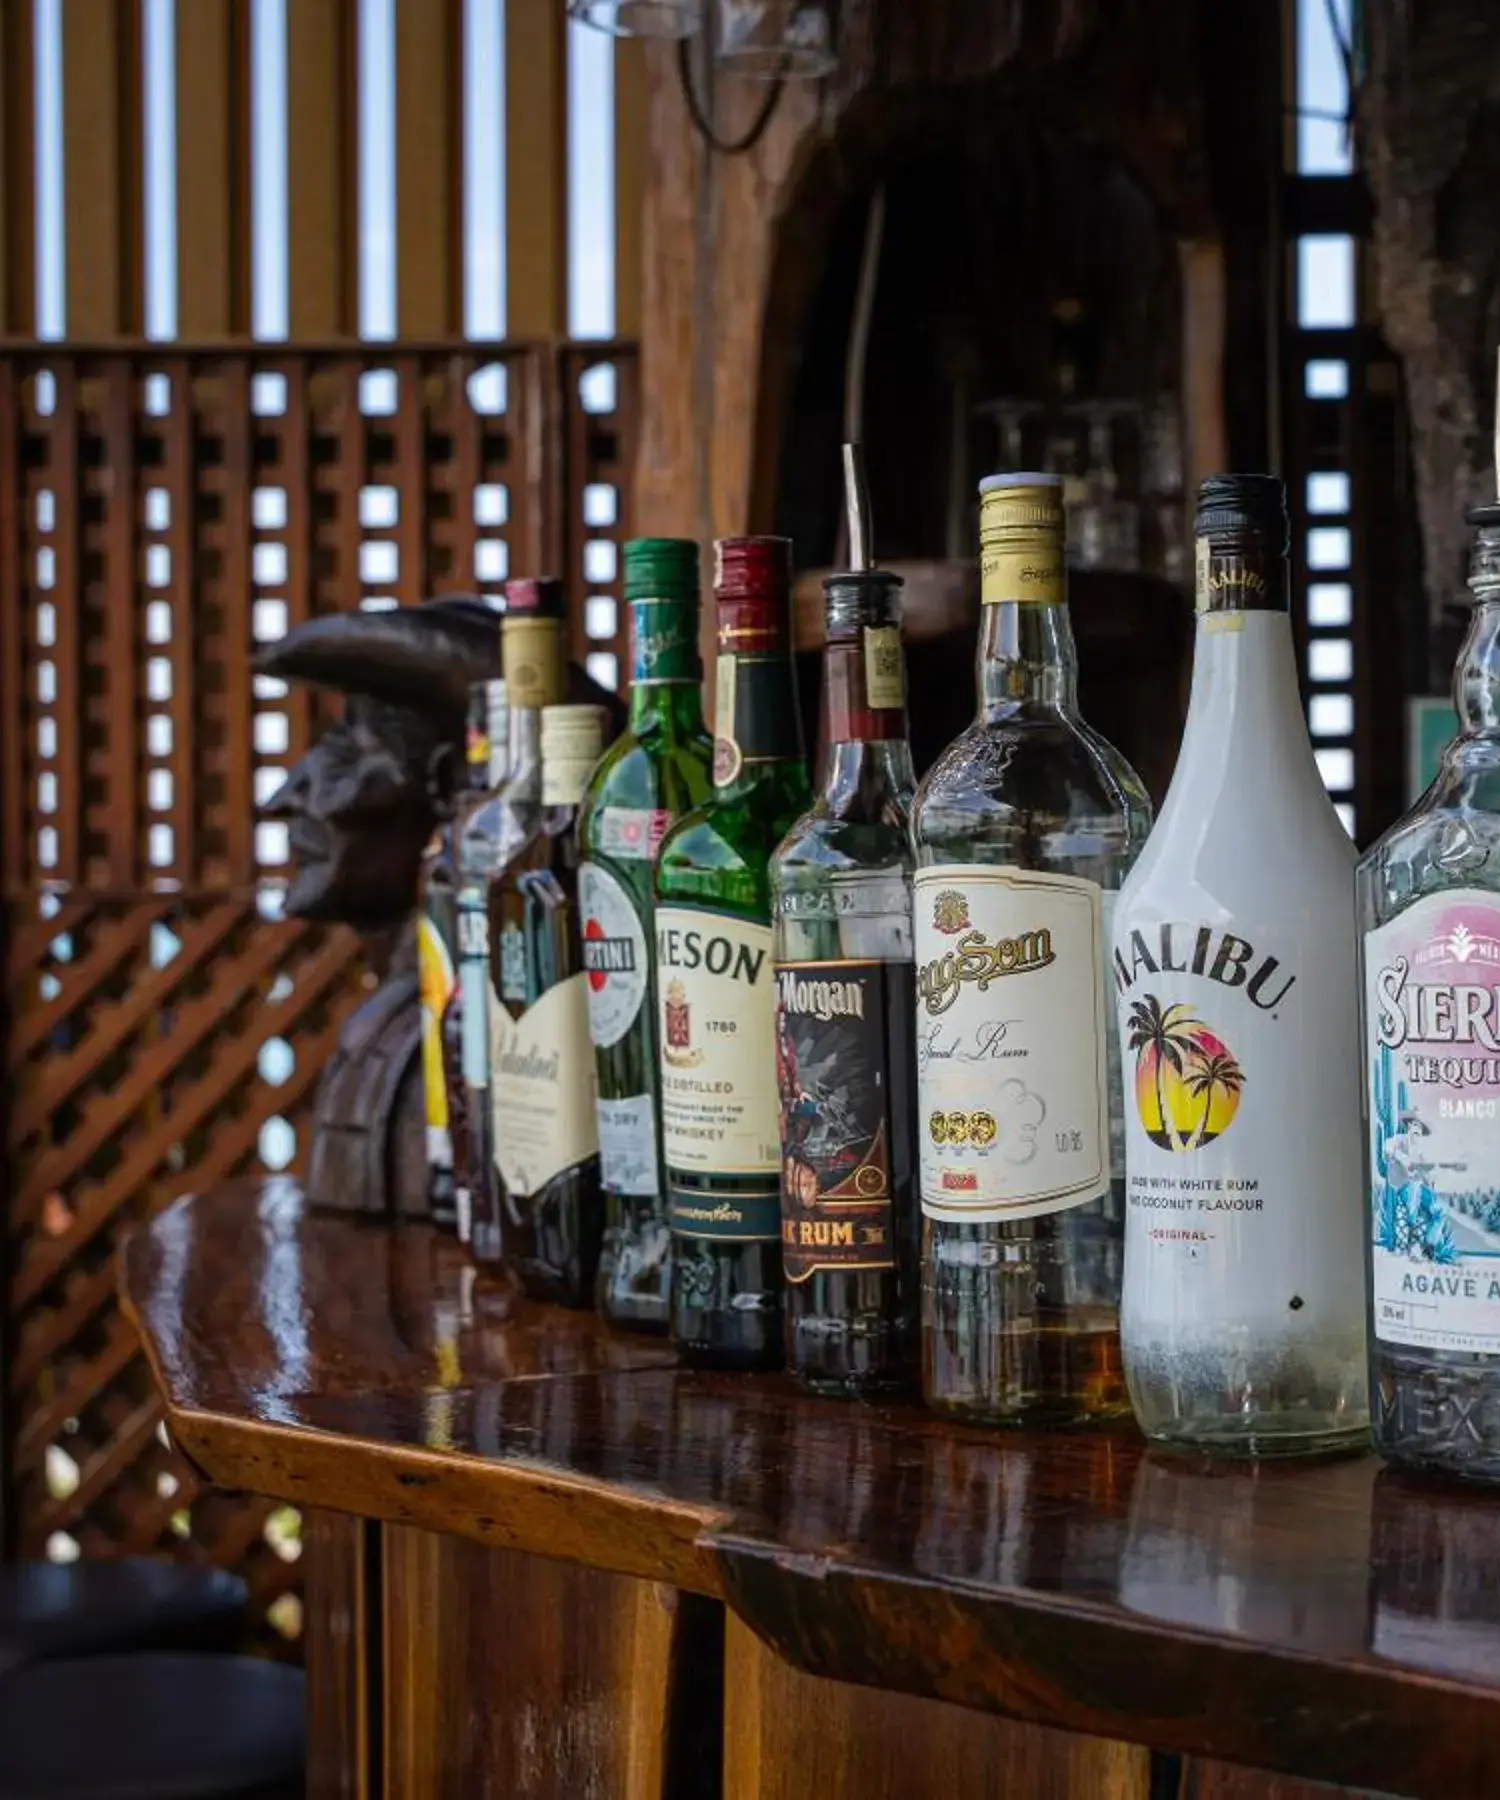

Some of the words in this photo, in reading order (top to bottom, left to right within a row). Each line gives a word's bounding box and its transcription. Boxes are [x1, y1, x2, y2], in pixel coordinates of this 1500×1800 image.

[584, 940, 632, 969] RTINI
[658, 928, 767, 986] ESON
[778, 970, 867, 1021] Morgan
[1438, 1099, 1497, 1120] BLANCO
[1179, 1179, 1224, 1192] WHITE
[1226, 1180, 1259, 1192] RUM
[1141, 1195, 1194, 1210] COCONUT
[1198, 1198, 1265, 1212] FLAVOUR
[799, 1220, 856, 1247] RUM
[1402, 1272, 1477, 1299] AGAVE
